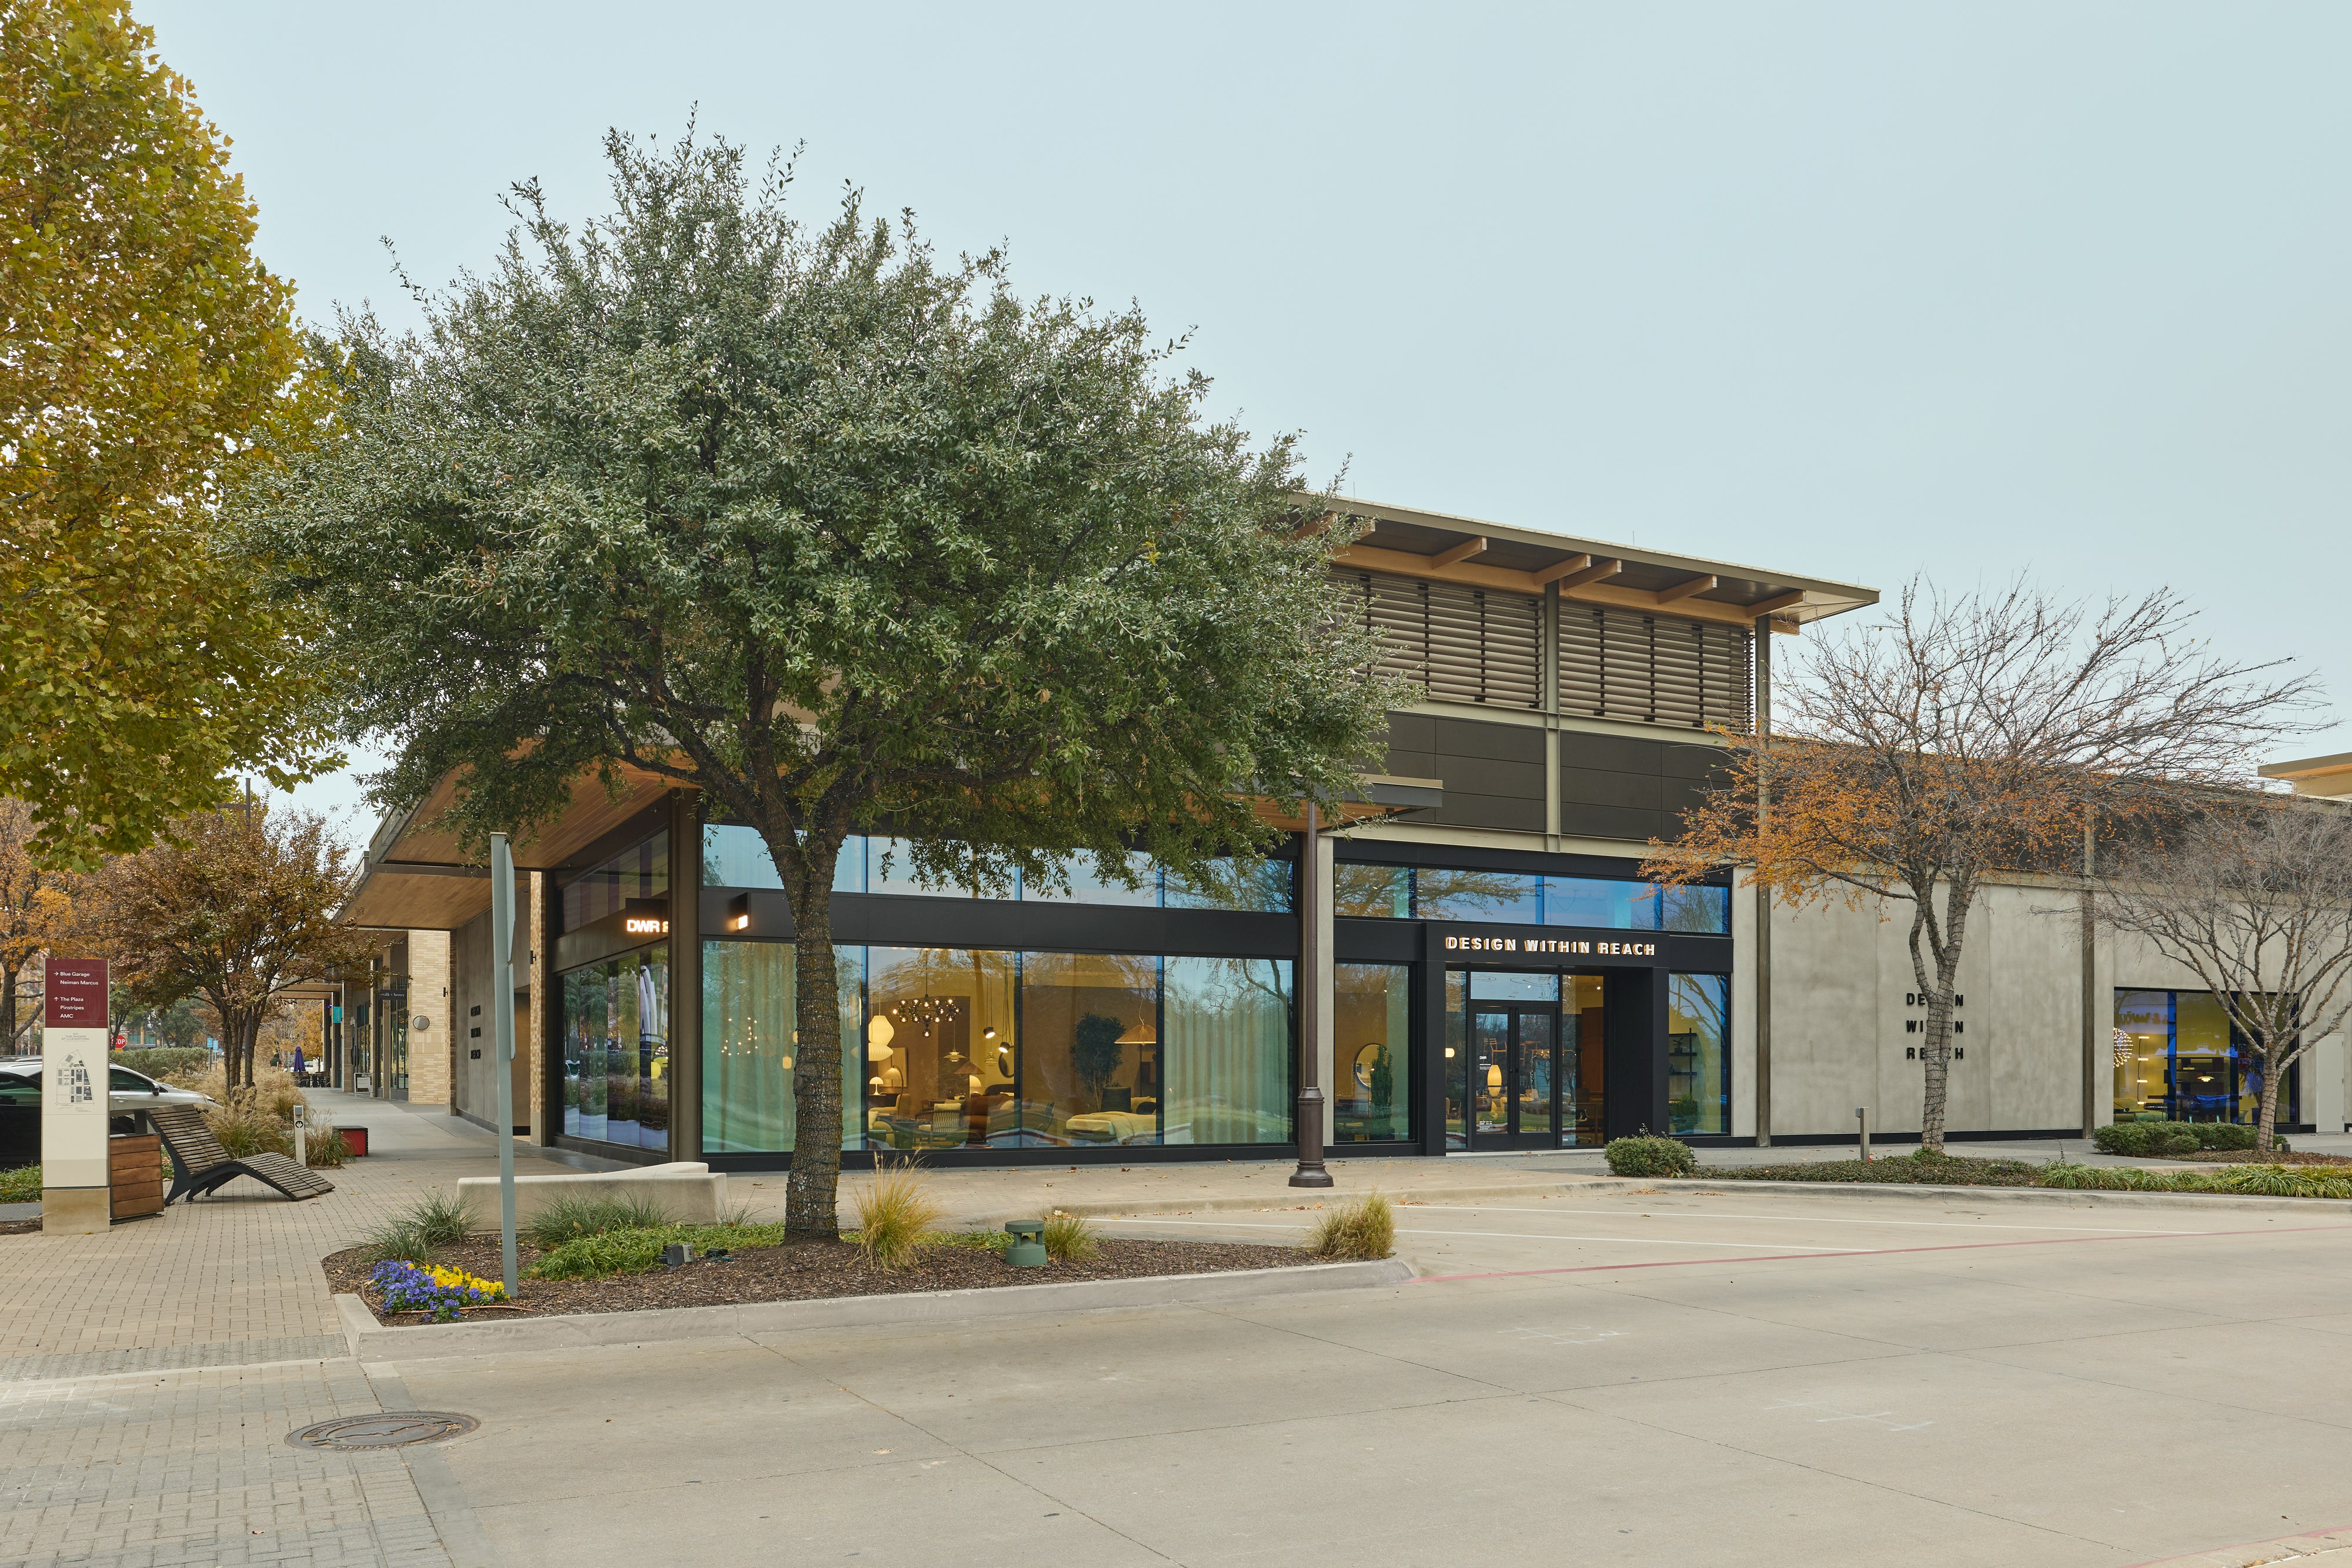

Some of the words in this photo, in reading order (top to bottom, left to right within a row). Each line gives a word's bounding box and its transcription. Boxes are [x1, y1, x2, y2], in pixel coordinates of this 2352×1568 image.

[627, 920, 660, 932] DWR
[1445, 937, 1516, 951] DESIGN
[1524, 940, 1590, 954] WITHIN
[1597, 942, 1655, 956] REACH
[1906, 992, 1964, 1006] DEN
[1906, 1020, 1964, 1033] WIN
[1906, 1047, 1964, 1059] REH
